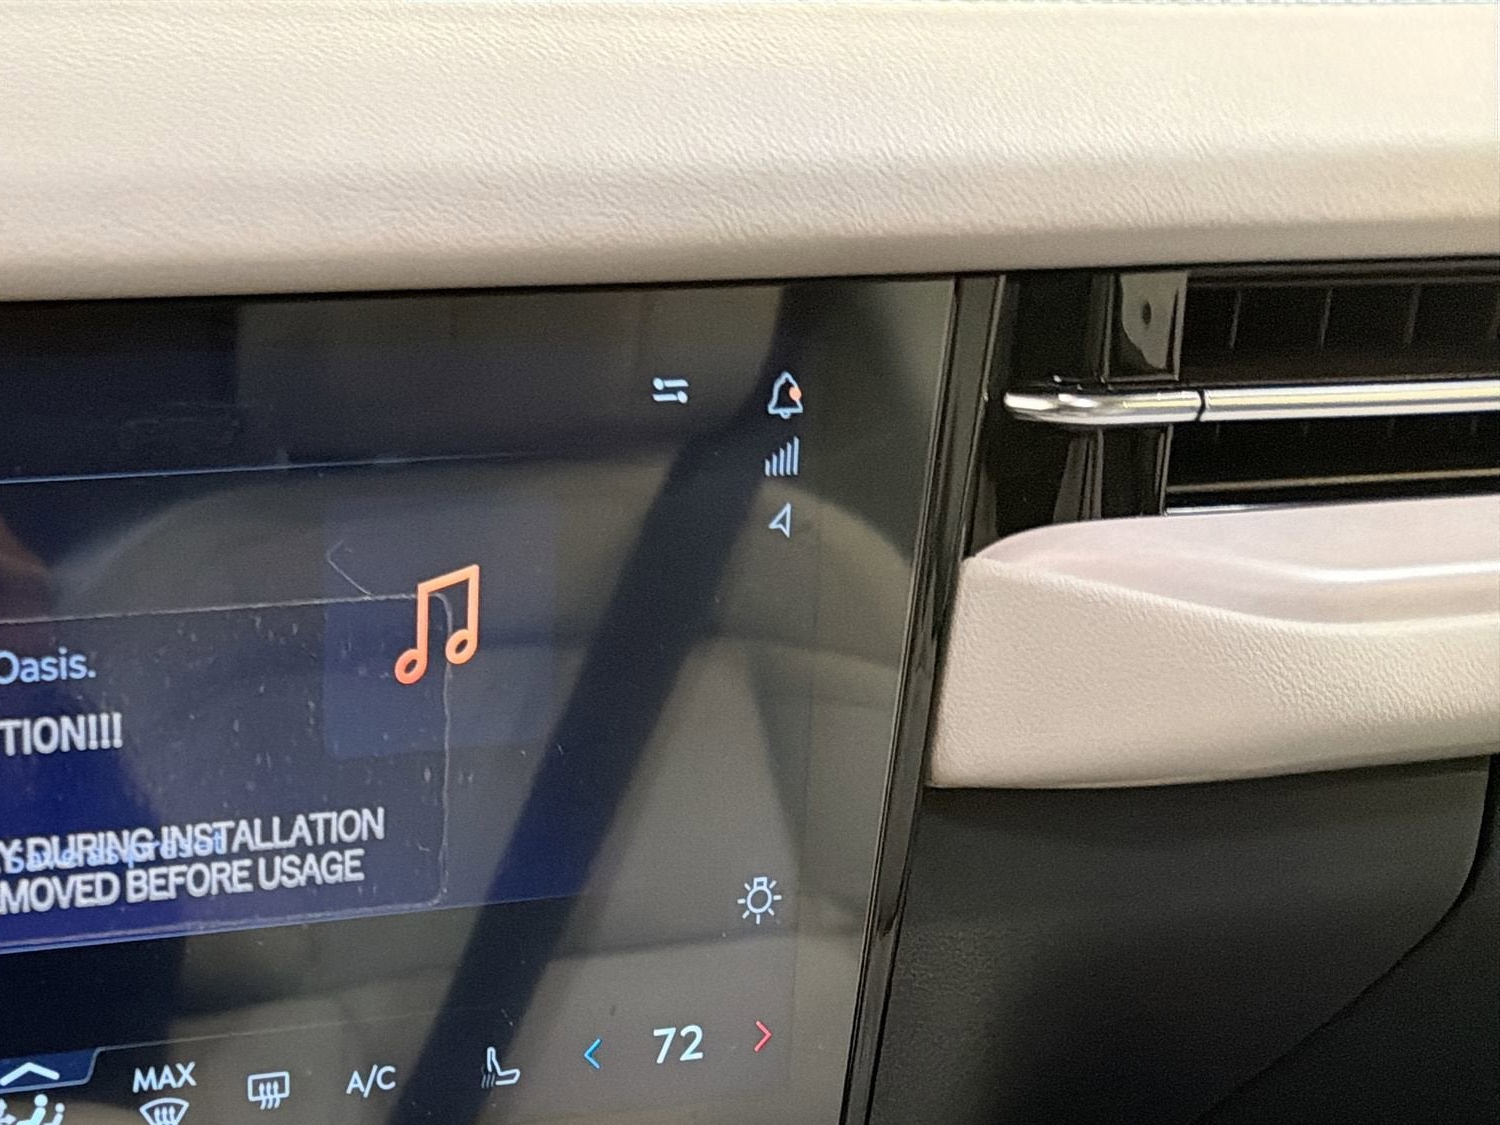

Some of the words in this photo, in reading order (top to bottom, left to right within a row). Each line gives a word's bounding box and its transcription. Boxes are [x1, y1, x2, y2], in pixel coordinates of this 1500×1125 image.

[25, 825, 155, 874] DURING
[160, 808, 384, 861] INSTALLATION
[125, 858, 254, 904] BEFORE
[257, 828, 366, 892] USAGE
[653, 1025, 706, 1066] 72
[130, 1062, 198, 1095] MAX
[345, 1065, 398, 1100] A/C
